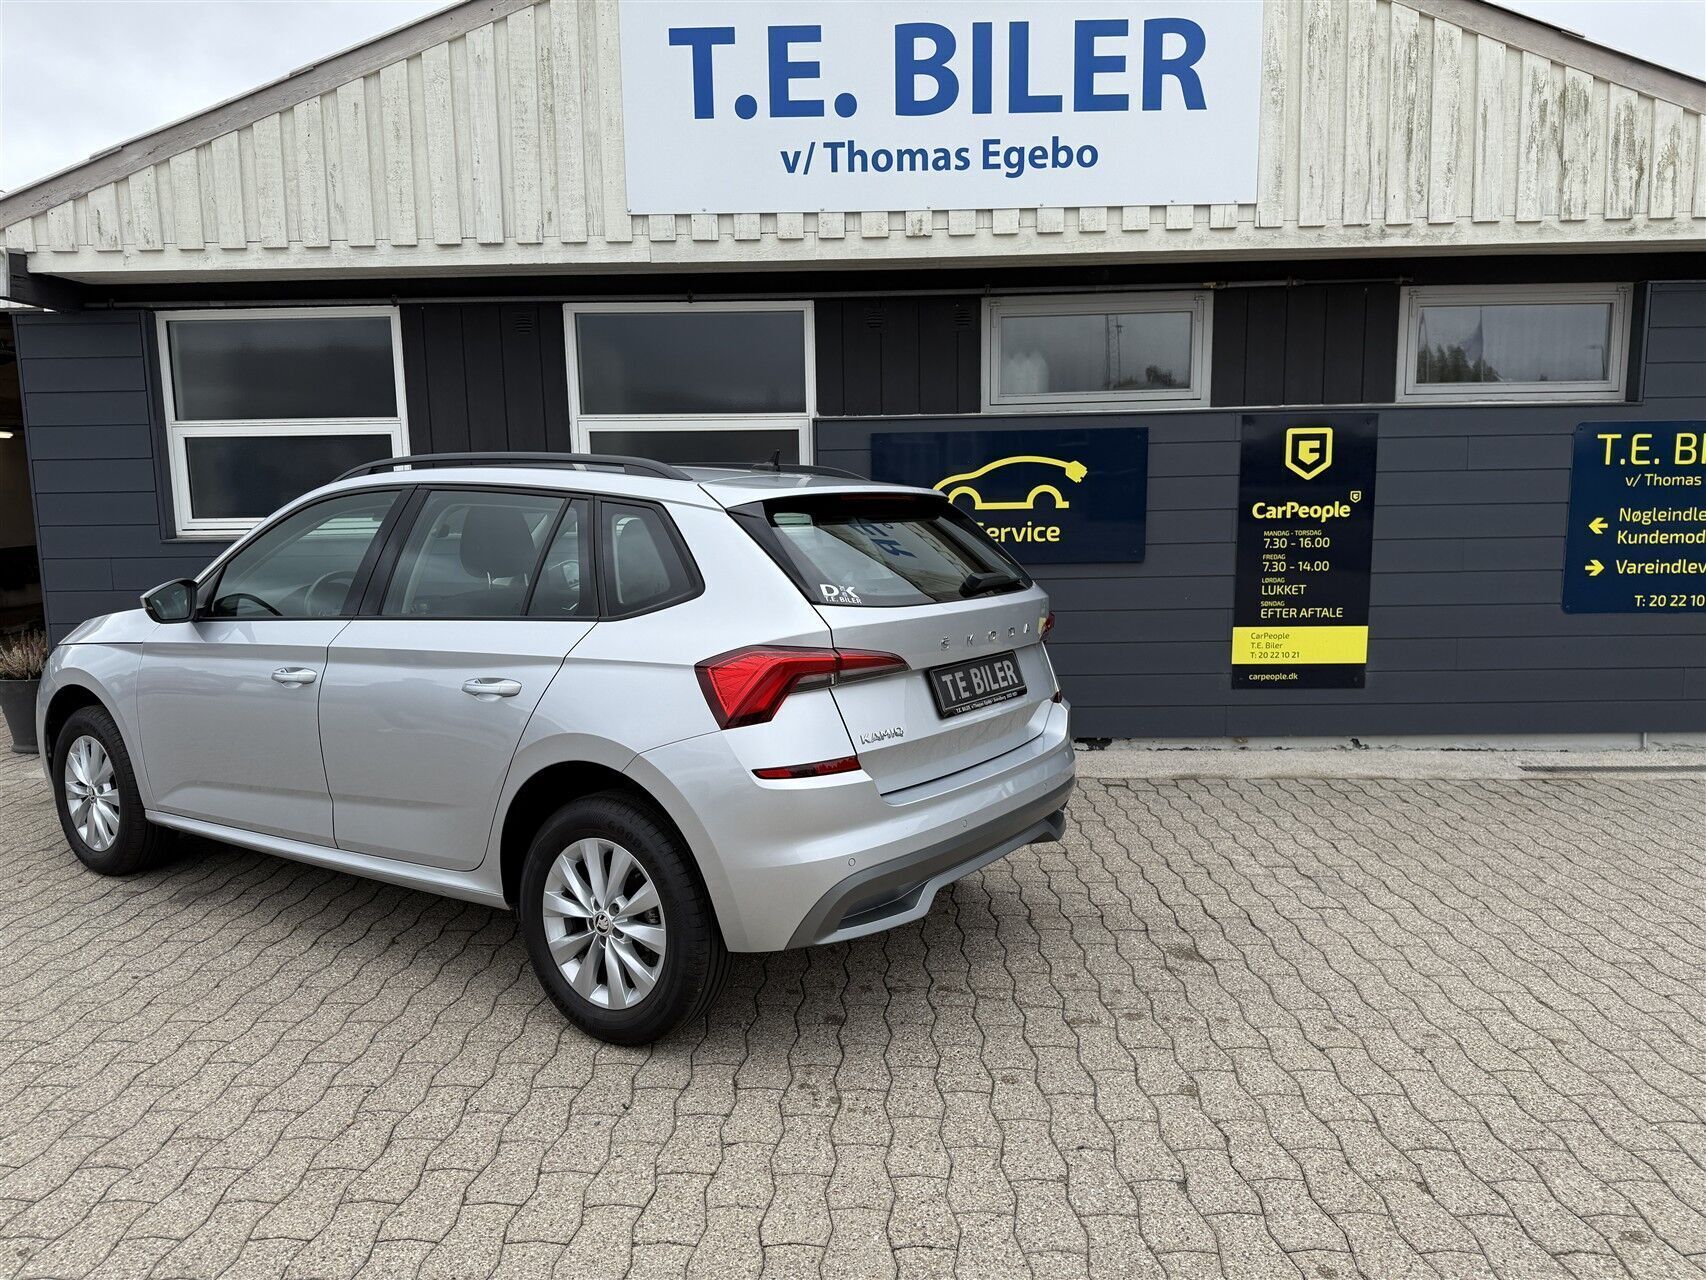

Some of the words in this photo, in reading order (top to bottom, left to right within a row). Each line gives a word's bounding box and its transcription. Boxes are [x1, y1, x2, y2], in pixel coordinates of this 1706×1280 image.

[668, 25, 858, 120] T.E.
[895, 17, 1208, 116] BILER
[780, 142, 816, 176] v/
[823, 139, 970, 174] Thomas
[982, 135, 1099, 178] Egebo
[1597, 434, 1660, 465] T.E.
[1625, 474, 1641, 487] v/
[1645, 474, 1702, 486] Thomas
[1252, 501, 1350, 522] CarPeople
[1619, 507, 1706, 525] Nøgleindle
[976, 521, 1060, 543] ervice
[1617, 530, 1706, 544] Kundemod
[1264, 538, 1287, 548] 7.30
[1299, 537, 1330, 548] 16.00
[1263, 561, 1286, 572] 7.30
[1298, 561, 1329, 571] 14.00
[1616, 559, 1706, 574] Vareindlev
[1261, 585, 1307, 595] LUKKET
[1634, 595, 1646, 607] T:
[1649, 595, 1666, 607] 20
[1670, 595, 1686, 607] 22
[1691, 595, 1705, 606] 10
[1260, 608, 1297, 619] EFTER
[1299, 608, 1343, 617] AFTALE
[1251, 632, 1290, 640] CarPeople
[1265, 641, 1282, 649] Biler
[970, 660, 1018, 695] BILER
[1249, 672, 1298, 681] carpeople.dk
